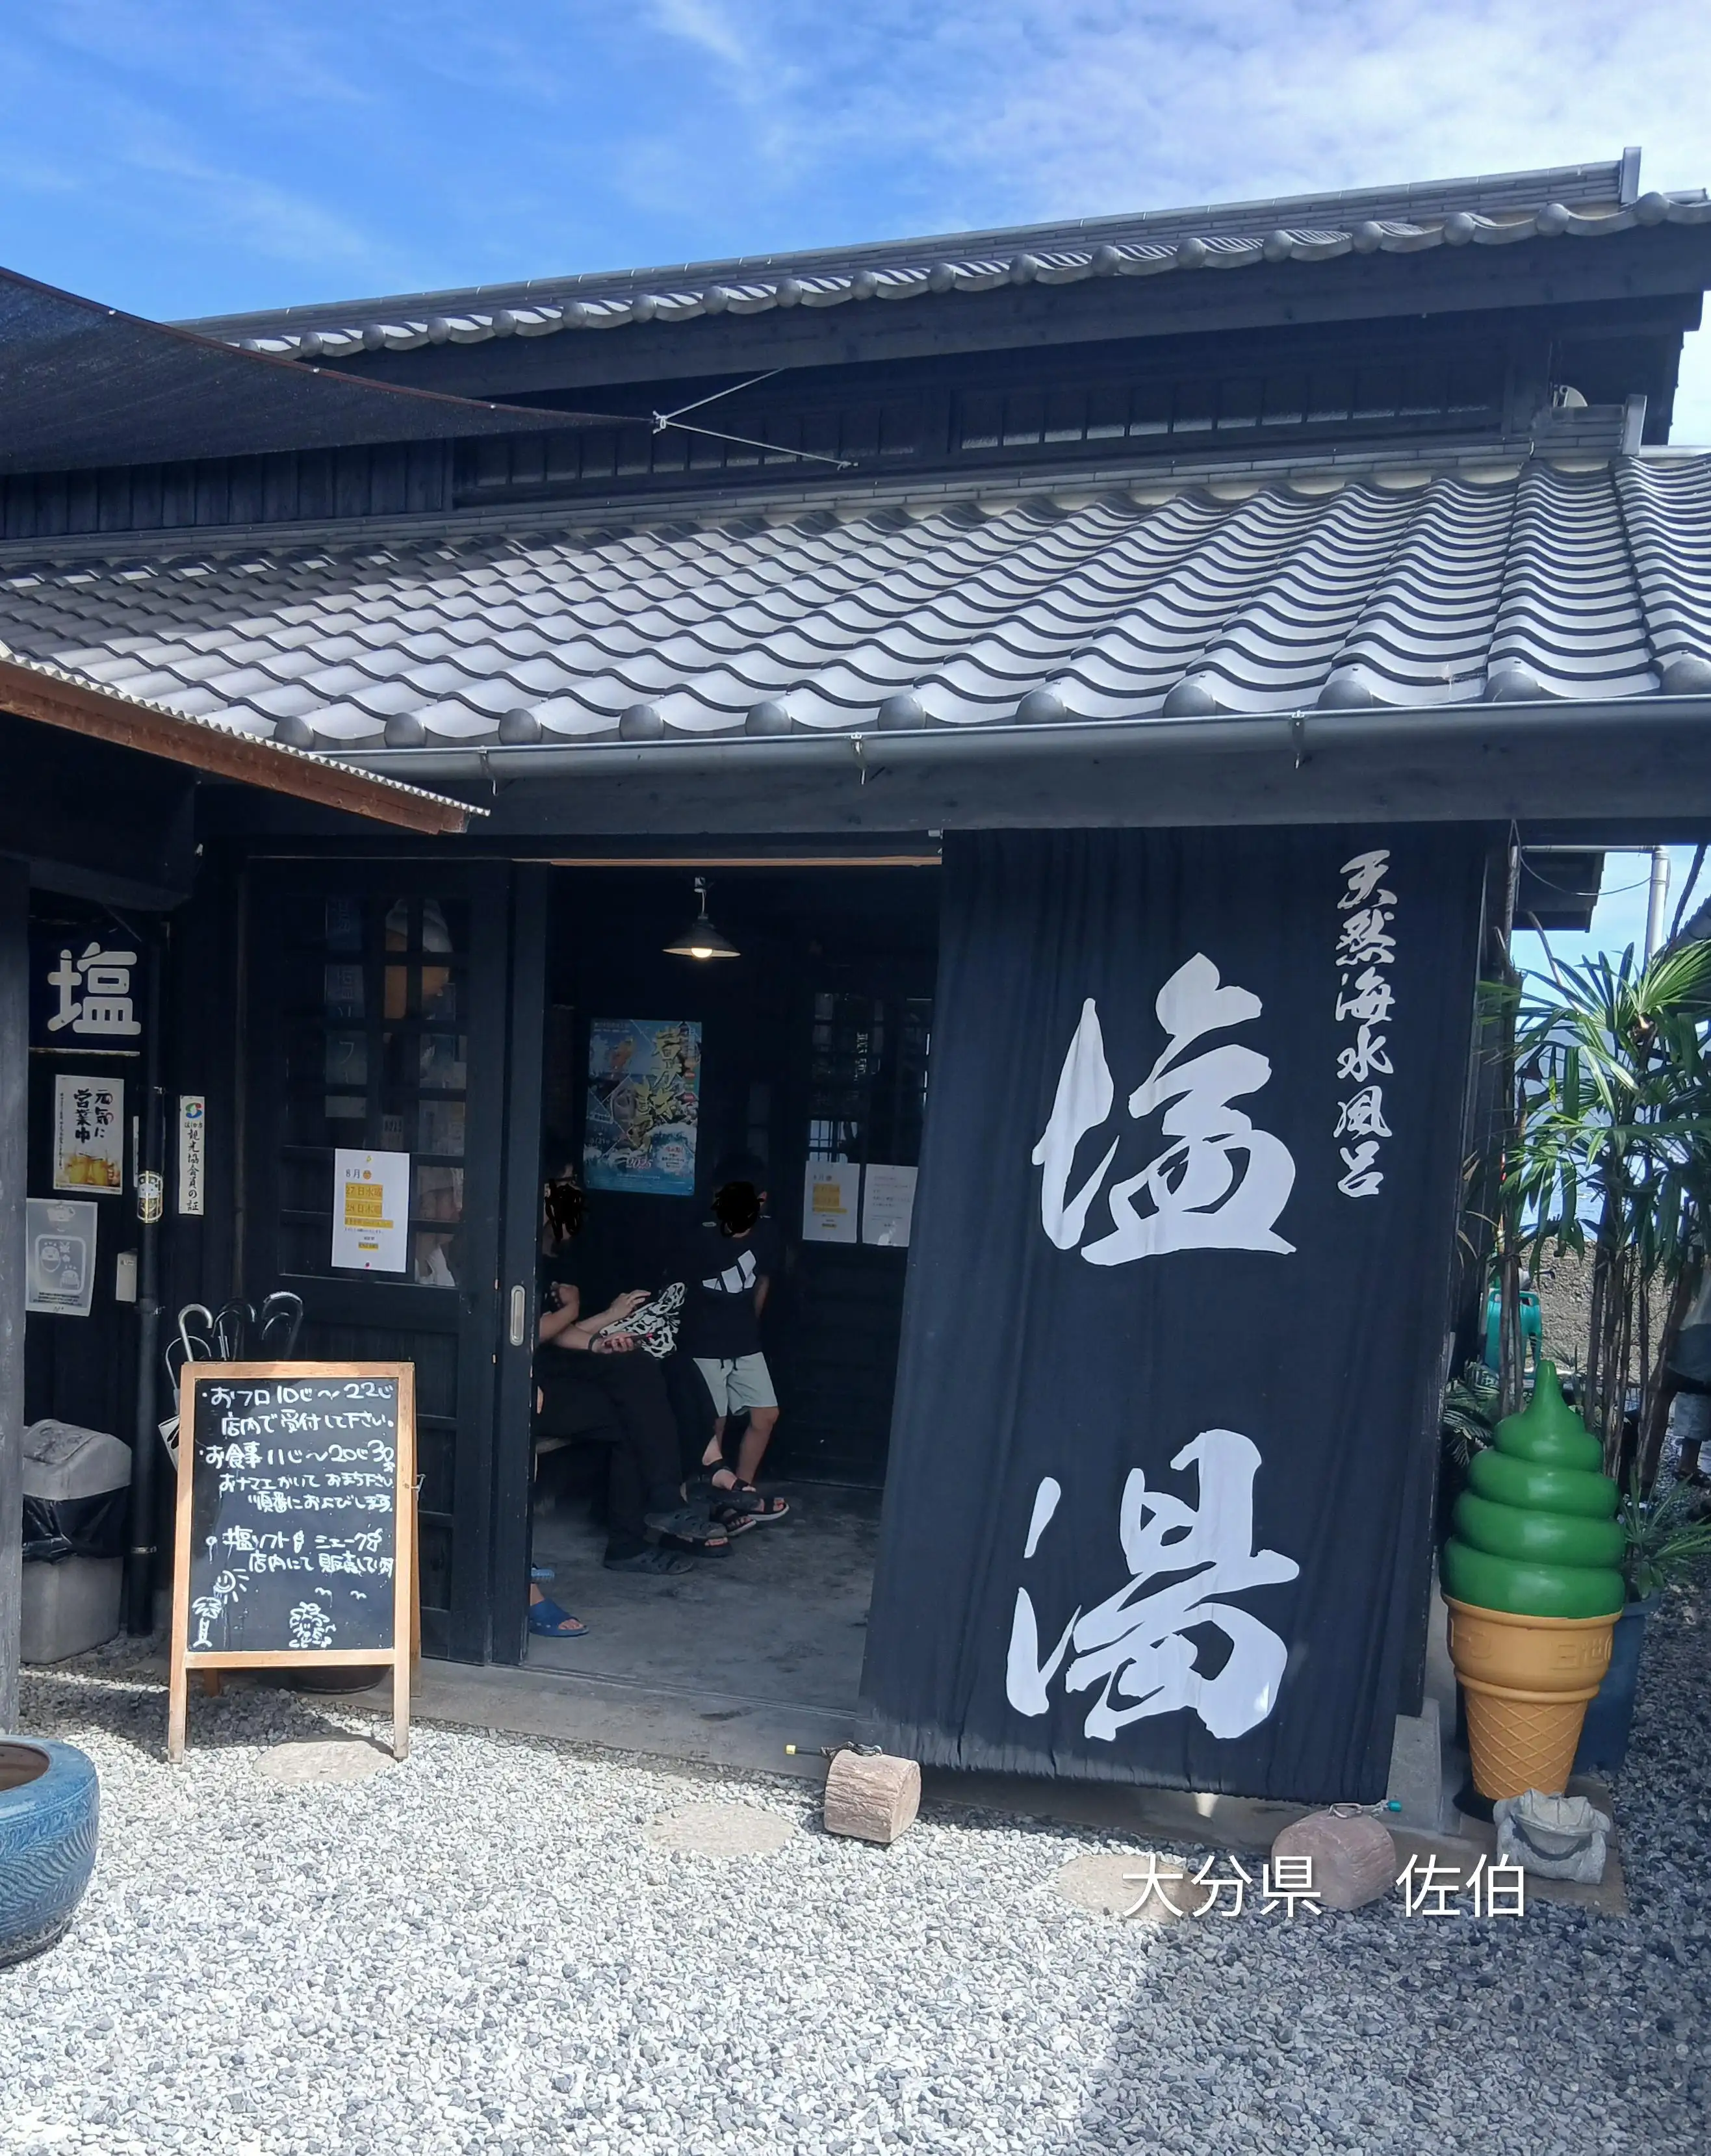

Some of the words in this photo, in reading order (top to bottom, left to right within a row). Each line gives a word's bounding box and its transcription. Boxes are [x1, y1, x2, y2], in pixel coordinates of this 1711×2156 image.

[47, 942, 141, 1034] 塩
[1333, 850, 1397, 1198] 天然海水風呂
[73, 1088, 92, 1144] 営業中
[94, 1089, 114, 1138] 元気に
[626, 1157, 652, 1168] 2025
